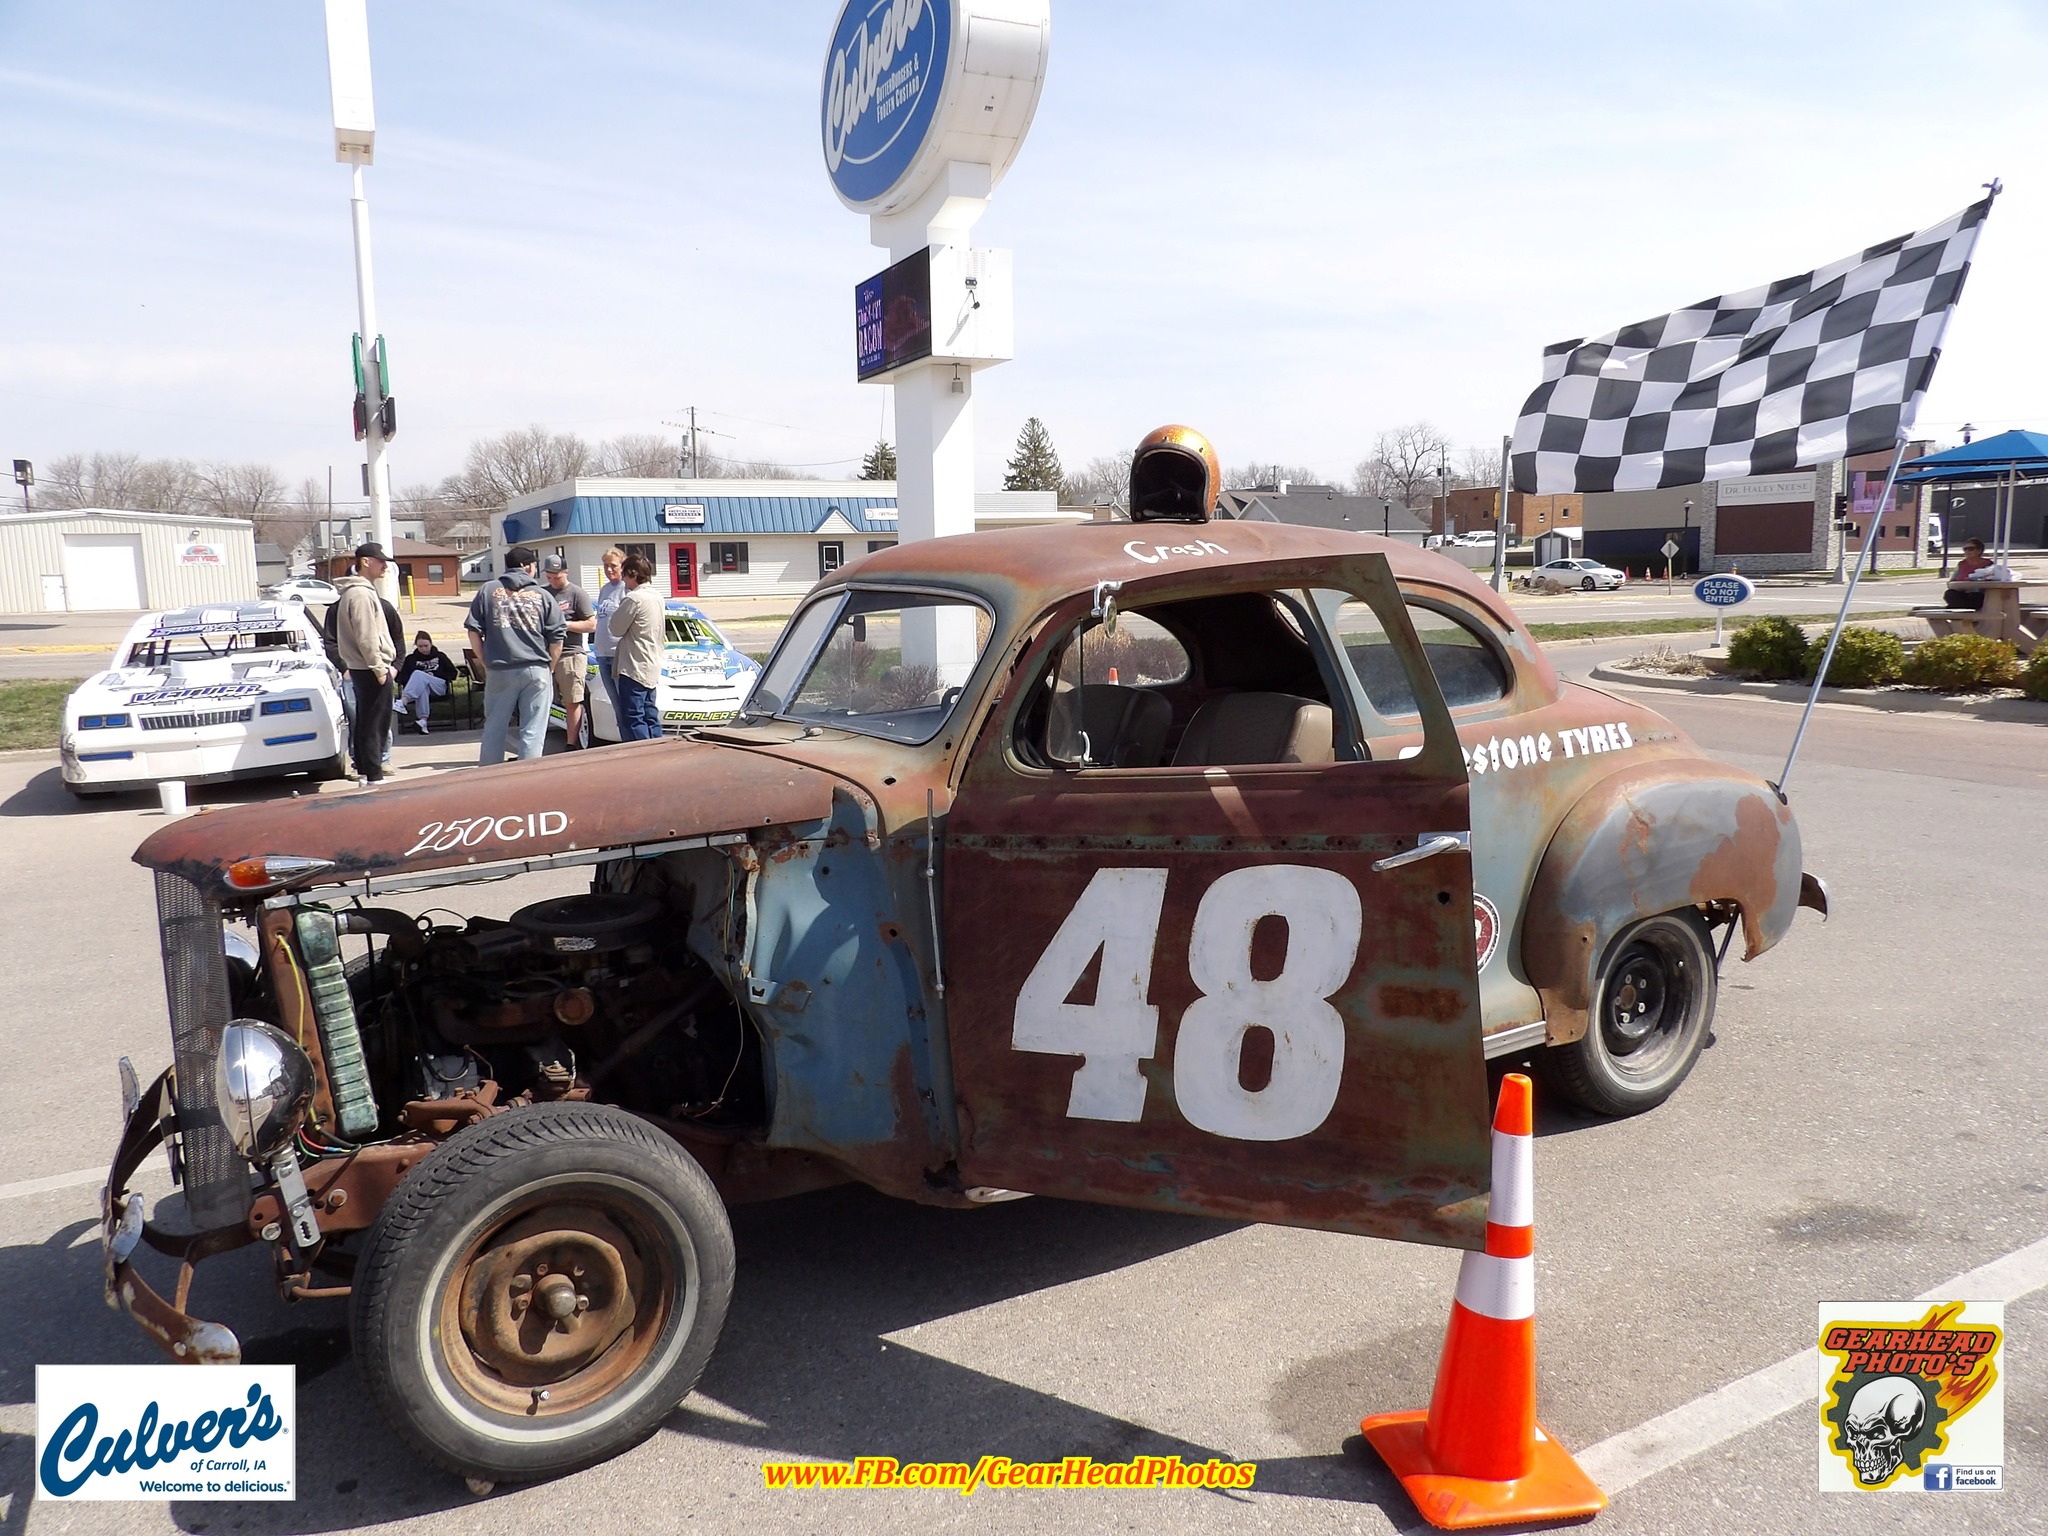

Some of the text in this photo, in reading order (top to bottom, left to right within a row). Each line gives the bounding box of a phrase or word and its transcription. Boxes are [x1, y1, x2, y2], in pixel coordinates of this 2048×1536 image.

[825, 0, 924, 173] Culver
[895, 75, 920, 108] CUSTARD
[1777, 482, 1808, 491] NEESE
[1123, 540, 1229, 564] Crash
[1702, 588, 1740, 597] DO NOT
[1704, 581, 1740, 589] PLEASE
[1705, 595, 1736, 603] ENTER
[1558, 722, 1634, 758] TYRES
[1011, 864, 1362, 1141] 48
